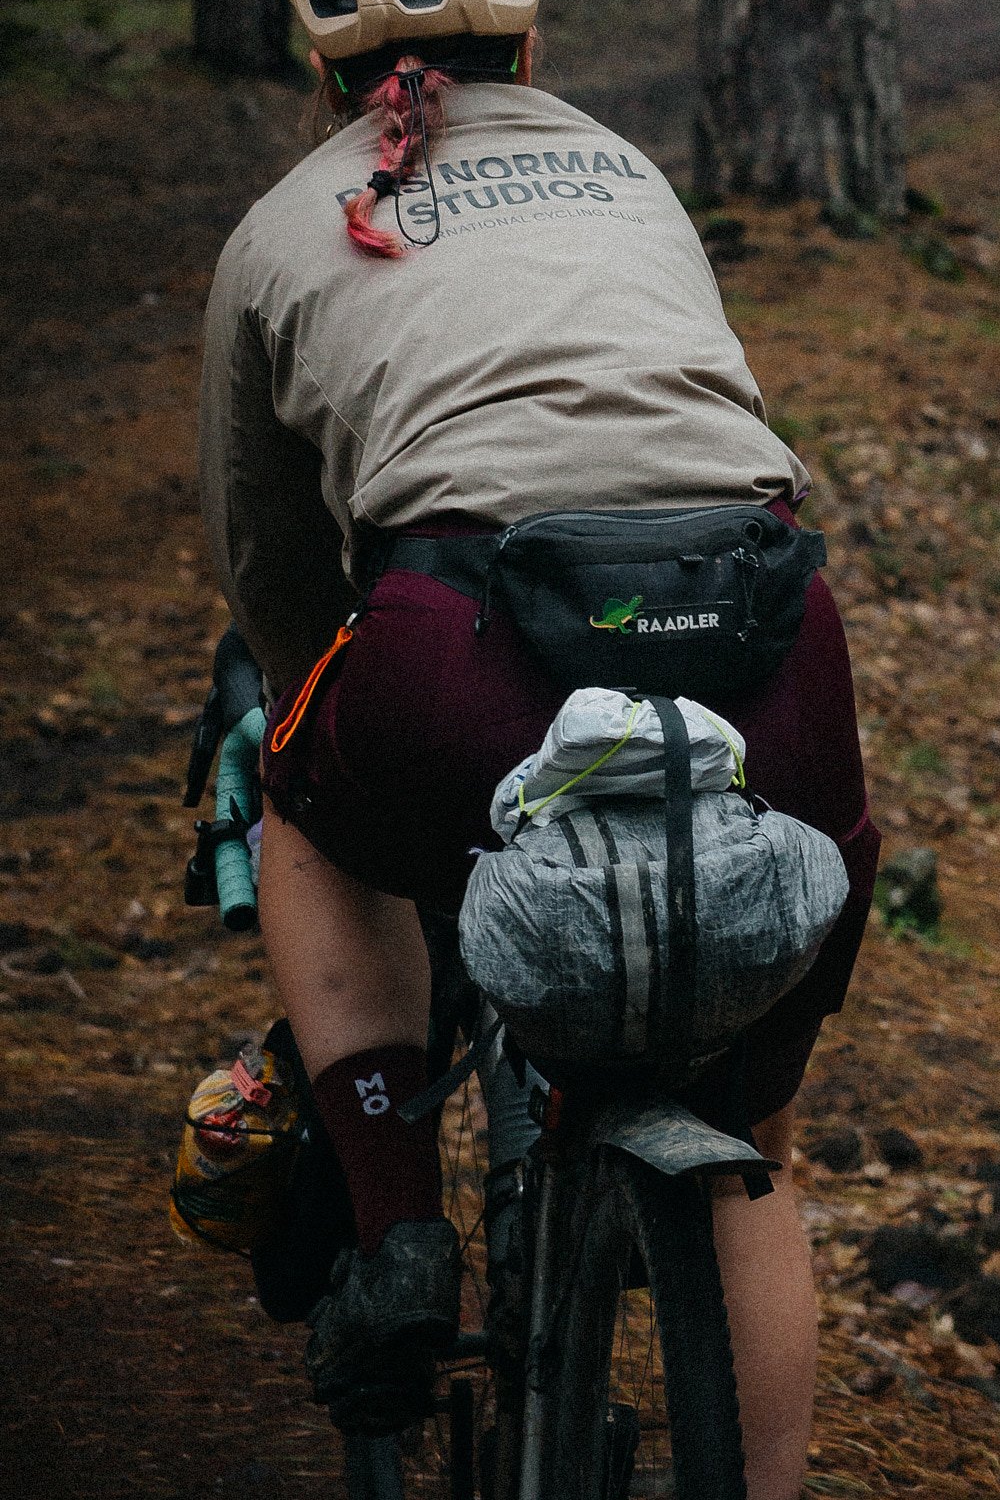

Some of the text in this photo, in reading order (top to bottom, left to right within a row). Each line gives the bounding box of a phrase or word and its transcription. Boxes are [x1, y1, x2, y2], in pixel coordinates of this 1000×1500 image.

[335, 150, 648, 209] PS NORMAL
[406, 179, 615, 225] STUDIOS
[532, 208, 604, 222] CYCLING
[608, 209, 646, 225] CLUB
[636, 612, 720, 633] RAADLER
